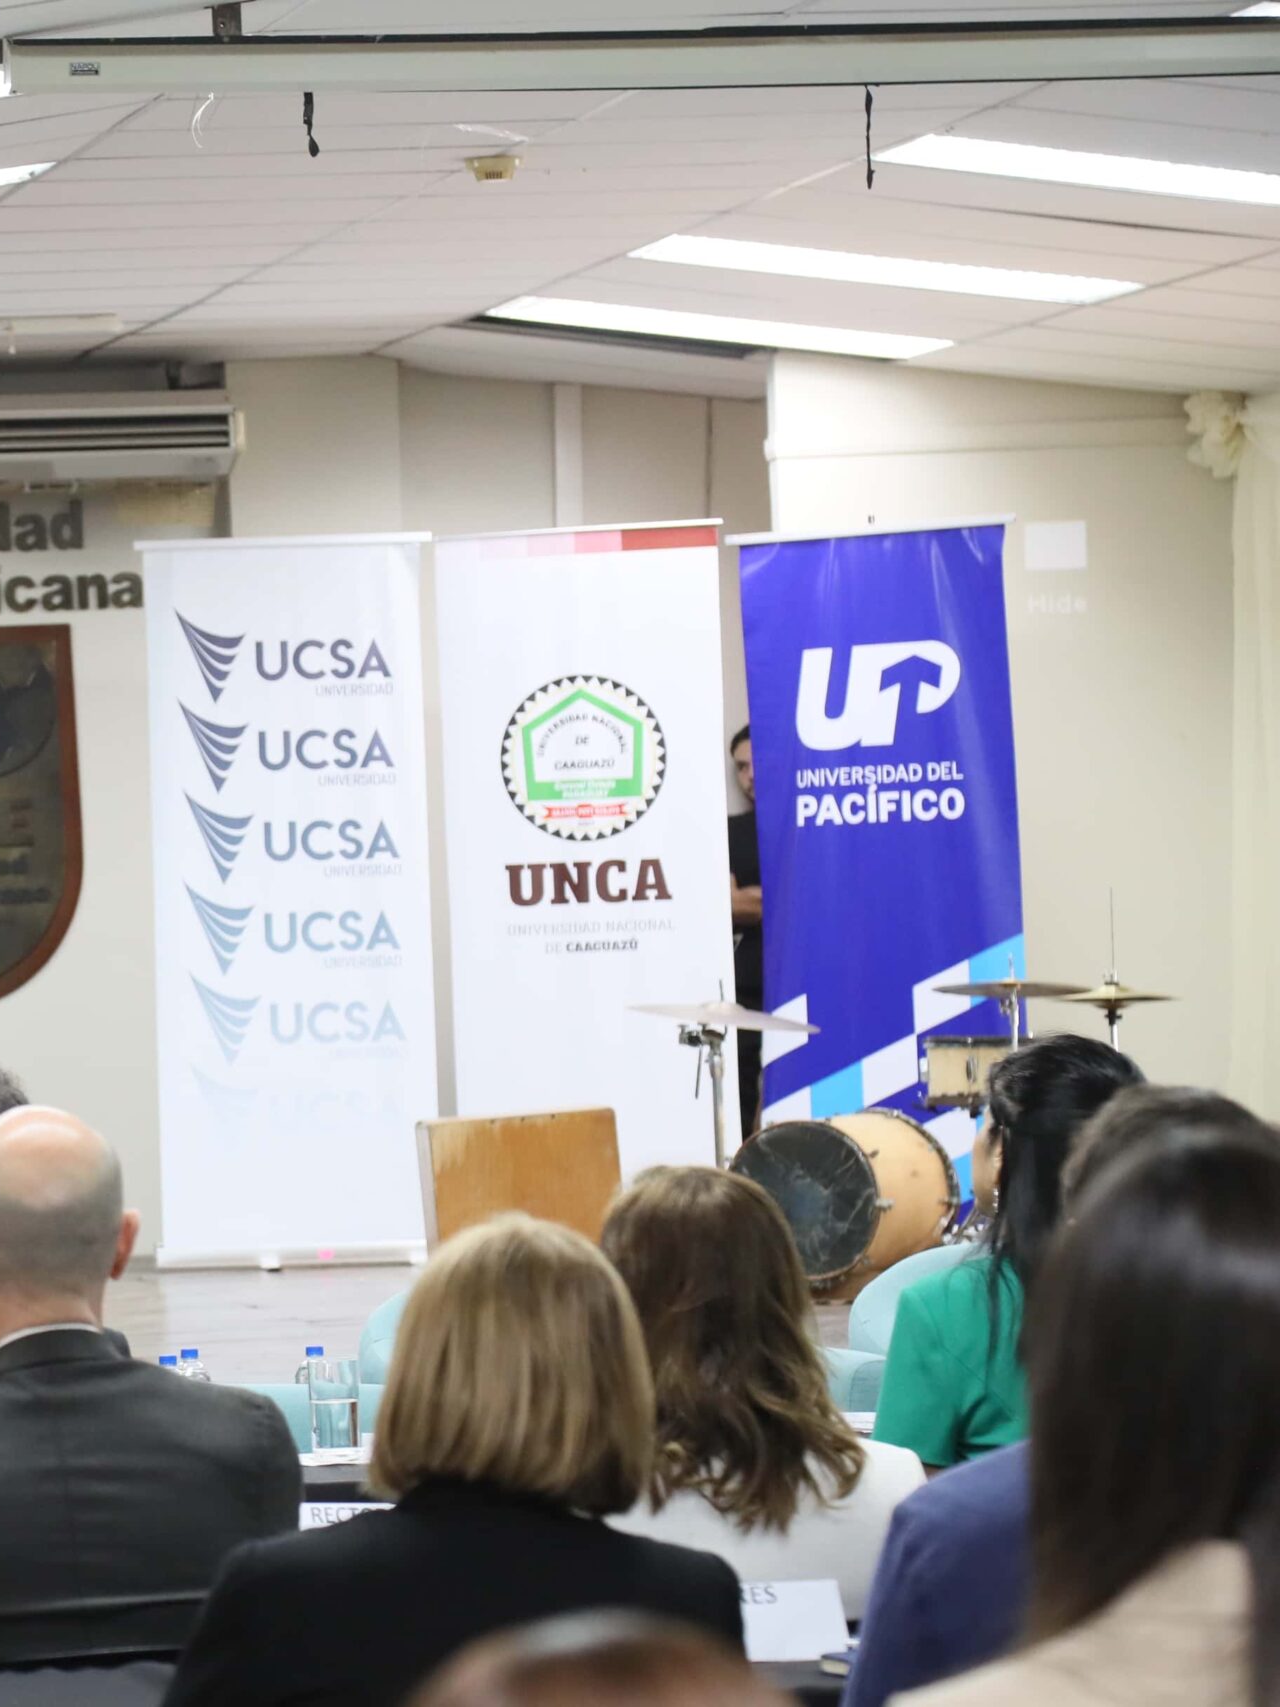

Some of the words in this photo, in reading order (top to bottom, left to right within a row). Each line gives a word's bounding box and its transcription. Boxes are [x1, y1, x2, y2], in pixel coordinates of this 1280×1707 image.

[255, 638, 392, 681] UCSA
[315, 682, 394, 697] UNIVERSIDAD
[258, 728, 395, 771] UCSA
[318, 772, 397, 787] UNIVERSIDAD
[796, 763, 922, 789] UNIVERSIDAD
[926, 761, 964, 781] DEL
[796, 785, 966, 828] PACÍFICO
[263, 819, 400, 862] UCSA
[323, 863, 403, 878] UNIVERSIDAD
[505, 858, 673, 907] UNCA
[263, 909, 401, 954] UCSA
[507, 920, 601, 937] UNIVERSIDAD
[606, 917, 676, 932] NACIONAL
[545, 942, 562, 954] DE
[566, 938, 638, 953] CAAGUAZÚ
[270, 999, 406, 1044] UCSA
